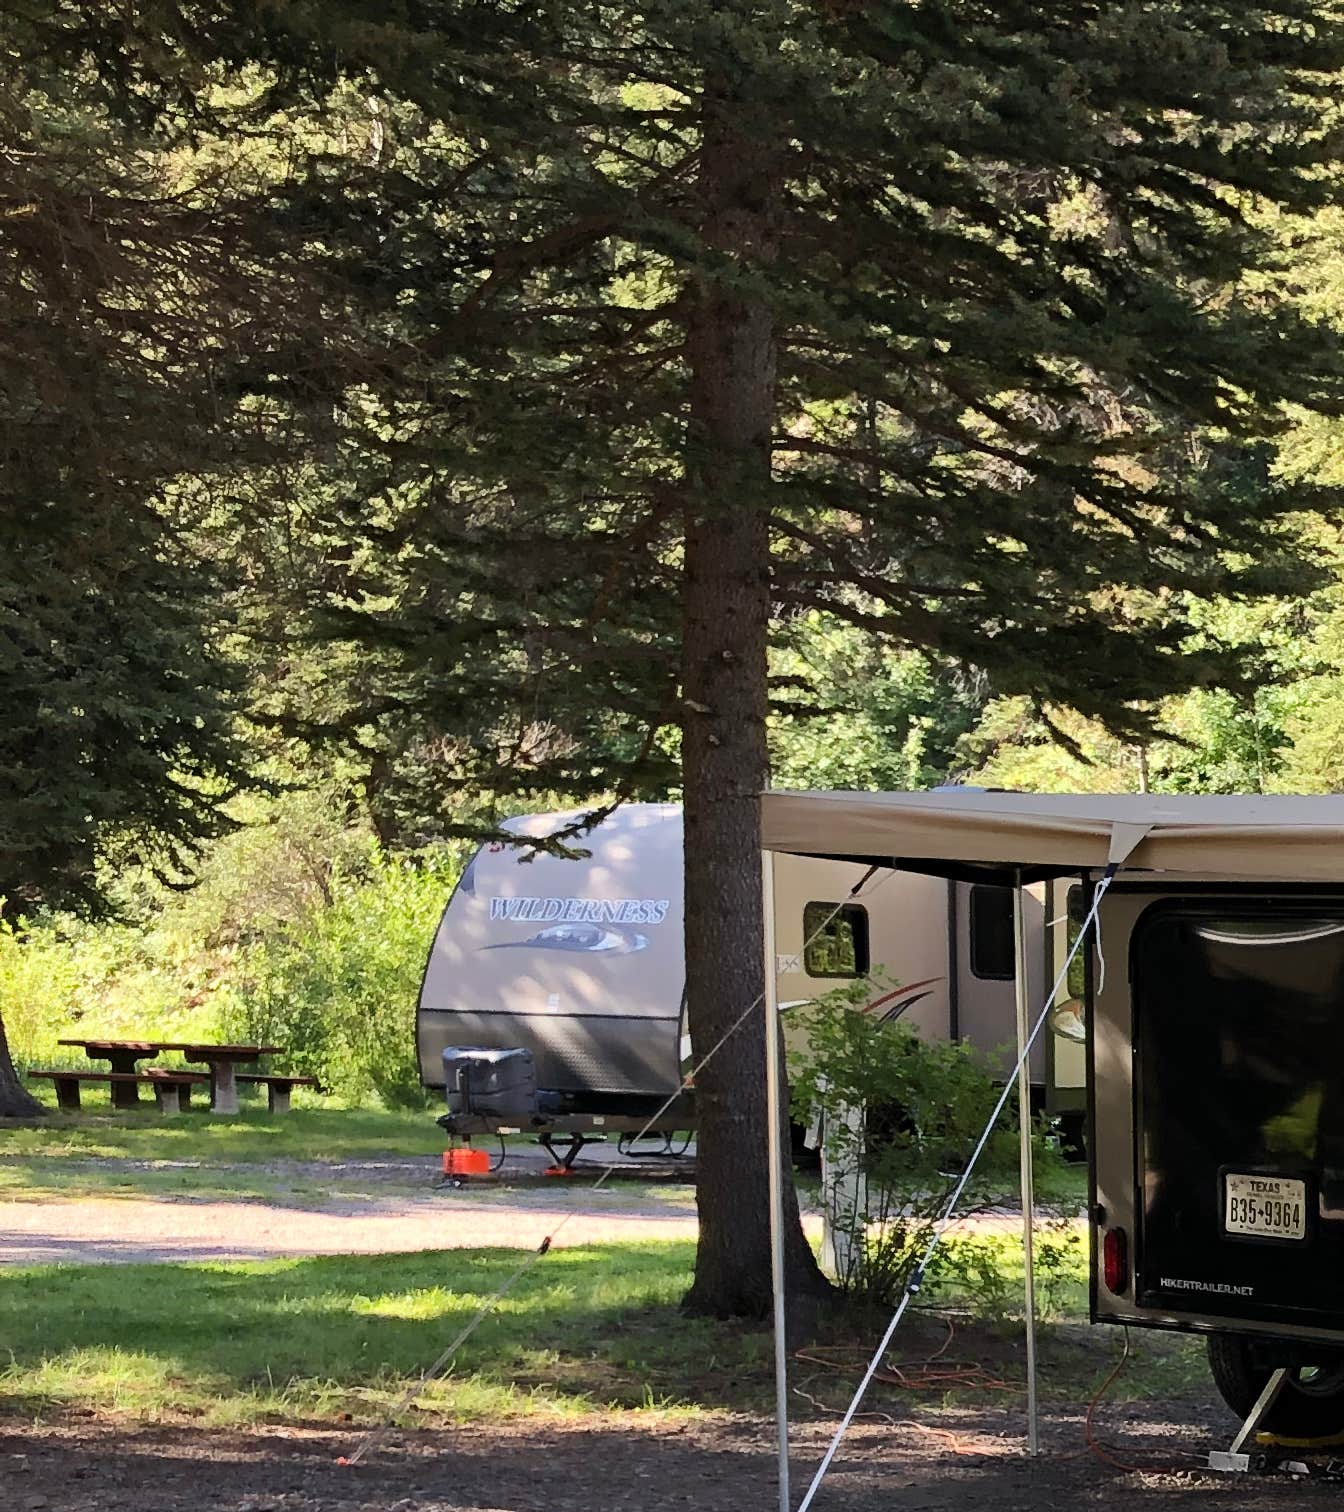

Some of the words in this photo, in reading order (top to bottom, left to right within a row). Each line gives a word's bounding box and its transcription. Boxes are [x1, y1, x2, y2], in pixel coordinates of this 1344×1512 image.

[488, 897, 670, 924] WILDERNESS
[1249, 1180, 1281, 1194] TEXAS
[1160, 1277, 1254, 1296] HIKERTRAILER.NET
